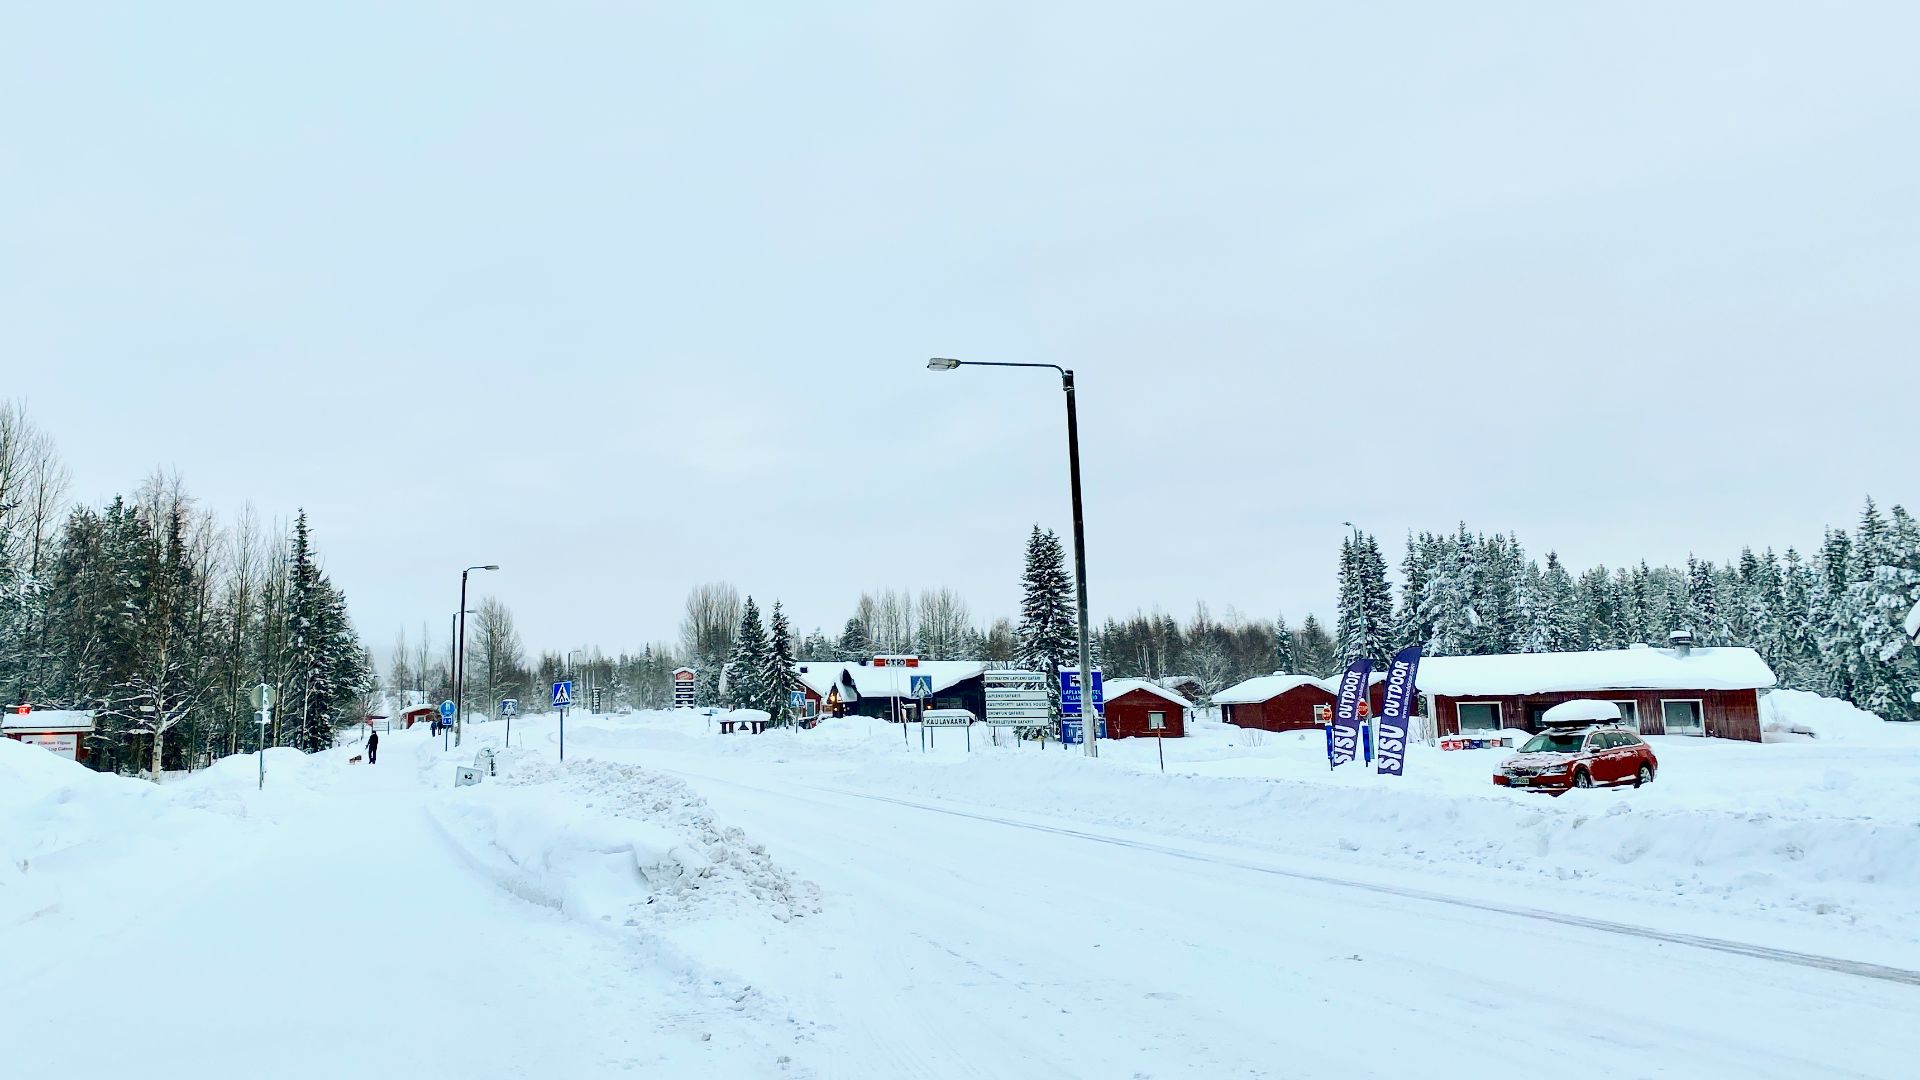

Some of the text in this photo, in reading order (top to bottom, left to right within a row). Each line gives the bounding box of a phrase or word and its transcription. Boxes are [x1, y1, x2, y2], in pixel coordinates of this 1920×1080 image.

[1338, 671, 1362, 719] OUTDOOR
[1378, 660, 1410, 771] SISU OUTDOOR
[926, 717, 967, 725] KAULAVAARA
[1335, 724, 1356, 764] SISU
